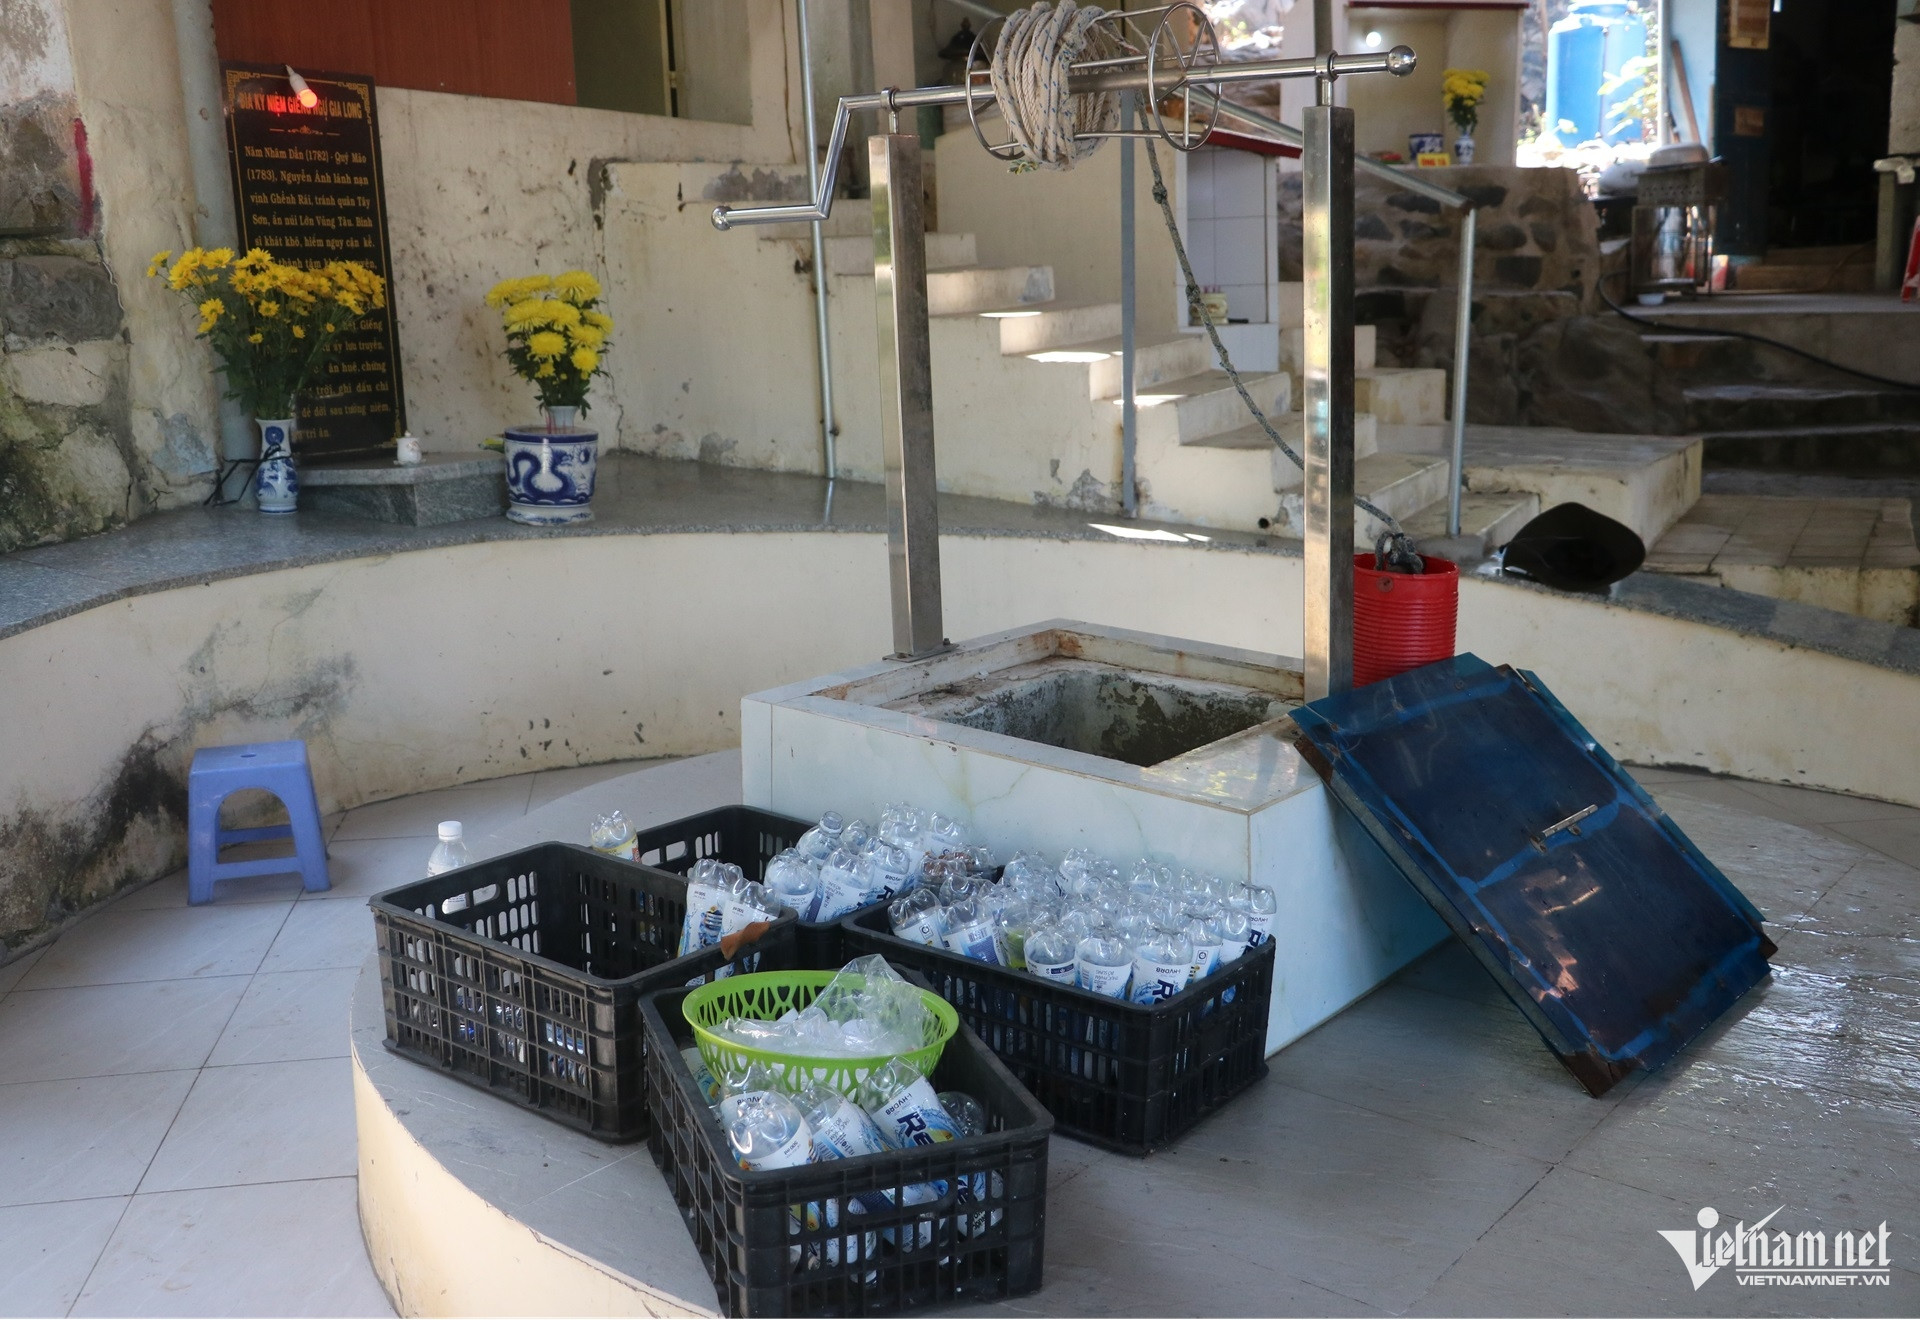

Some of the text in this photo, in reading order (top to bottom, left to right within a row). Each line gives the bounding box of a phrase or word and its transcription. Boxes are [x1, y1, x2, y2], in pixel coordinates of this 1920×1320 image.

[329, 100, 342, 117] GIA
[343, 101, 362, 119] LONG
[245, 146, 262, 157] Năm
[264, 146, 287, 159] Nhâm
[288, 146, 304, 160] Dần
[305, 149, 329, 162] (1782)
[334, 151, 349, 165] Quý
[280, 169, 312, 184] Nguyễn
[333, 172, 352, 184] lánh
[353, 176, 369, 187] nạn
[250, 192, 268, 206] vịnh
[315, 194, 336, 206] tránh
[337, 195, 356, 208] quân
[356, 195, 371, 209] Tây
[252, 214, 270, 226] Sơn,
[284, 214, 298, 226] núi
[300, 215, 315, 226] Lớn
[316, 215, 336, 230] Vũng
[263, 236, 283, 247] khát
[325, 238, 344, 250] nguy
[345, 237, 360, 248] cận
[360, 318, 383, 332] Giếng
[330, 407, 344, 416] sau
